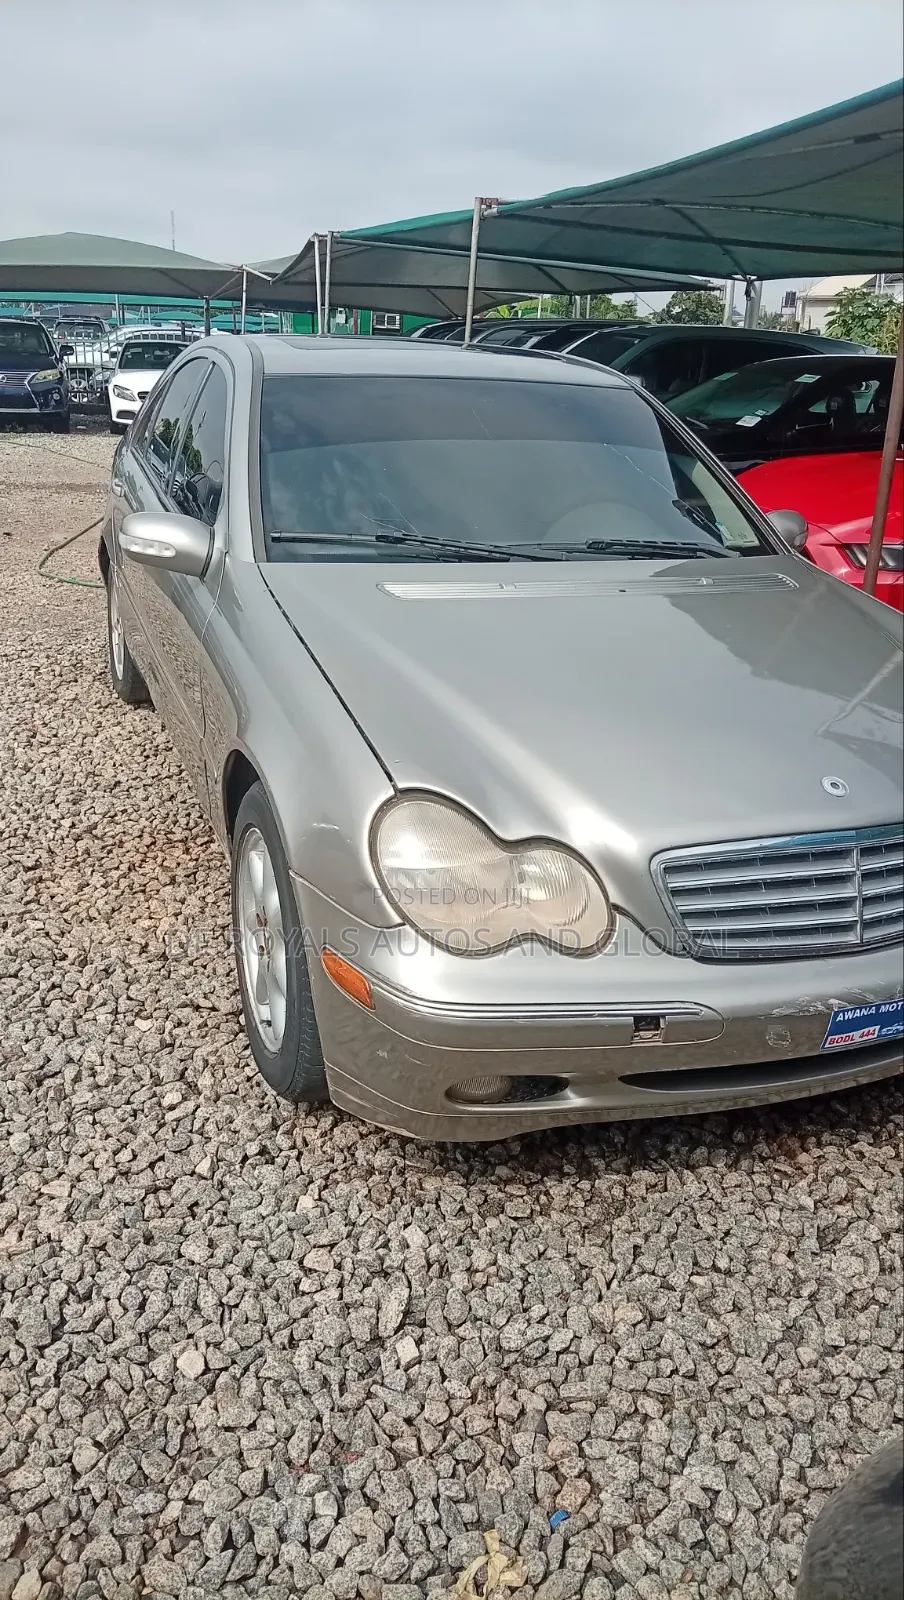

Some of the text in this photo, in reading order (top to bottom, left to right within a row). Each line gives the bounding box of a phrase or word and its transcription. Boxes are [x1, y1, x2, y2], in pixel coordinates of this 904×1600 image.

[836, 1002, 904, 1021] AWANA MOT
[828, 1028, 876, 1045] BODL 444
